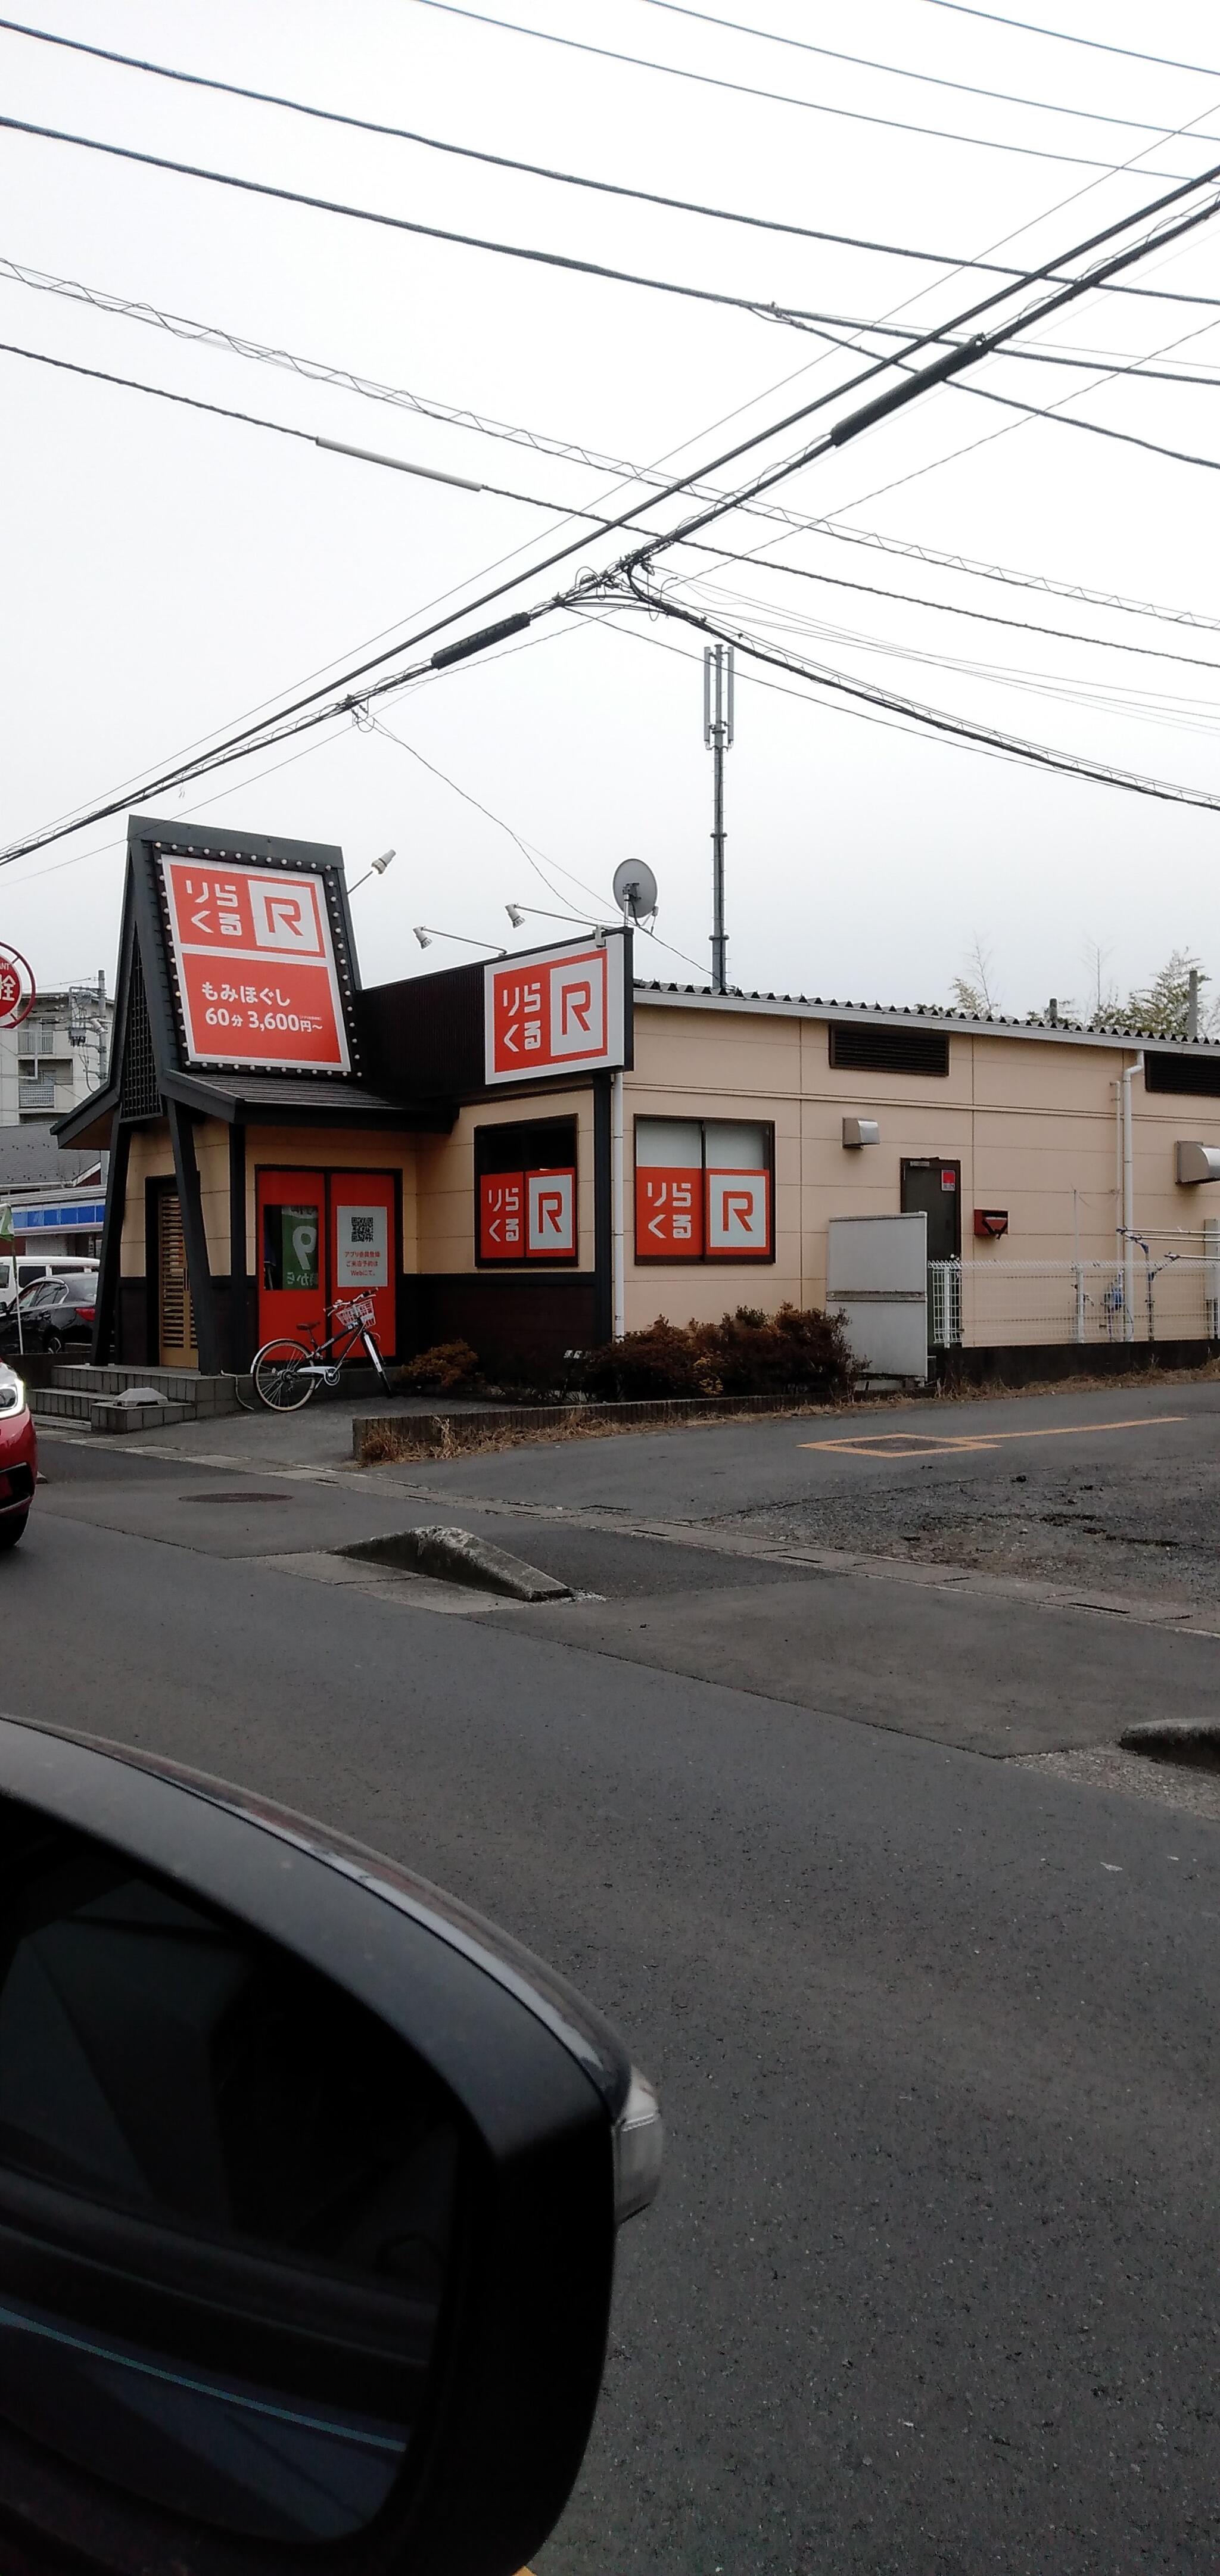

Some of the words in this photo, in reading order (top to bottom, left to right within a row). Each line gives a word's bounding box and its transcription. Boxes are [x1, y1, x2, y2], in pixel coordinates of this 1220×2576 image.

[185, 880, 238, 907] りら
[191, 910, 242, 936] くる
[263, 895, 304, 937] R
[201, 982, 290, 1007] もみほぐし
[502, 982, 541, 1017] りら
[206, 1007, 243, 1027] 60分
[561, 980, 592, 1036] R
[503, 1020, 541, 1053] くる
[488, 1187, 519, 1212] りら
[647, 1182, 691, 1207] りら
[537, 1191, 562, 1234] R
[721, 1190, 753, 1232] R
[488, 1218, 519, 1242] くる
[648, 1214, 691, 1239] くる
